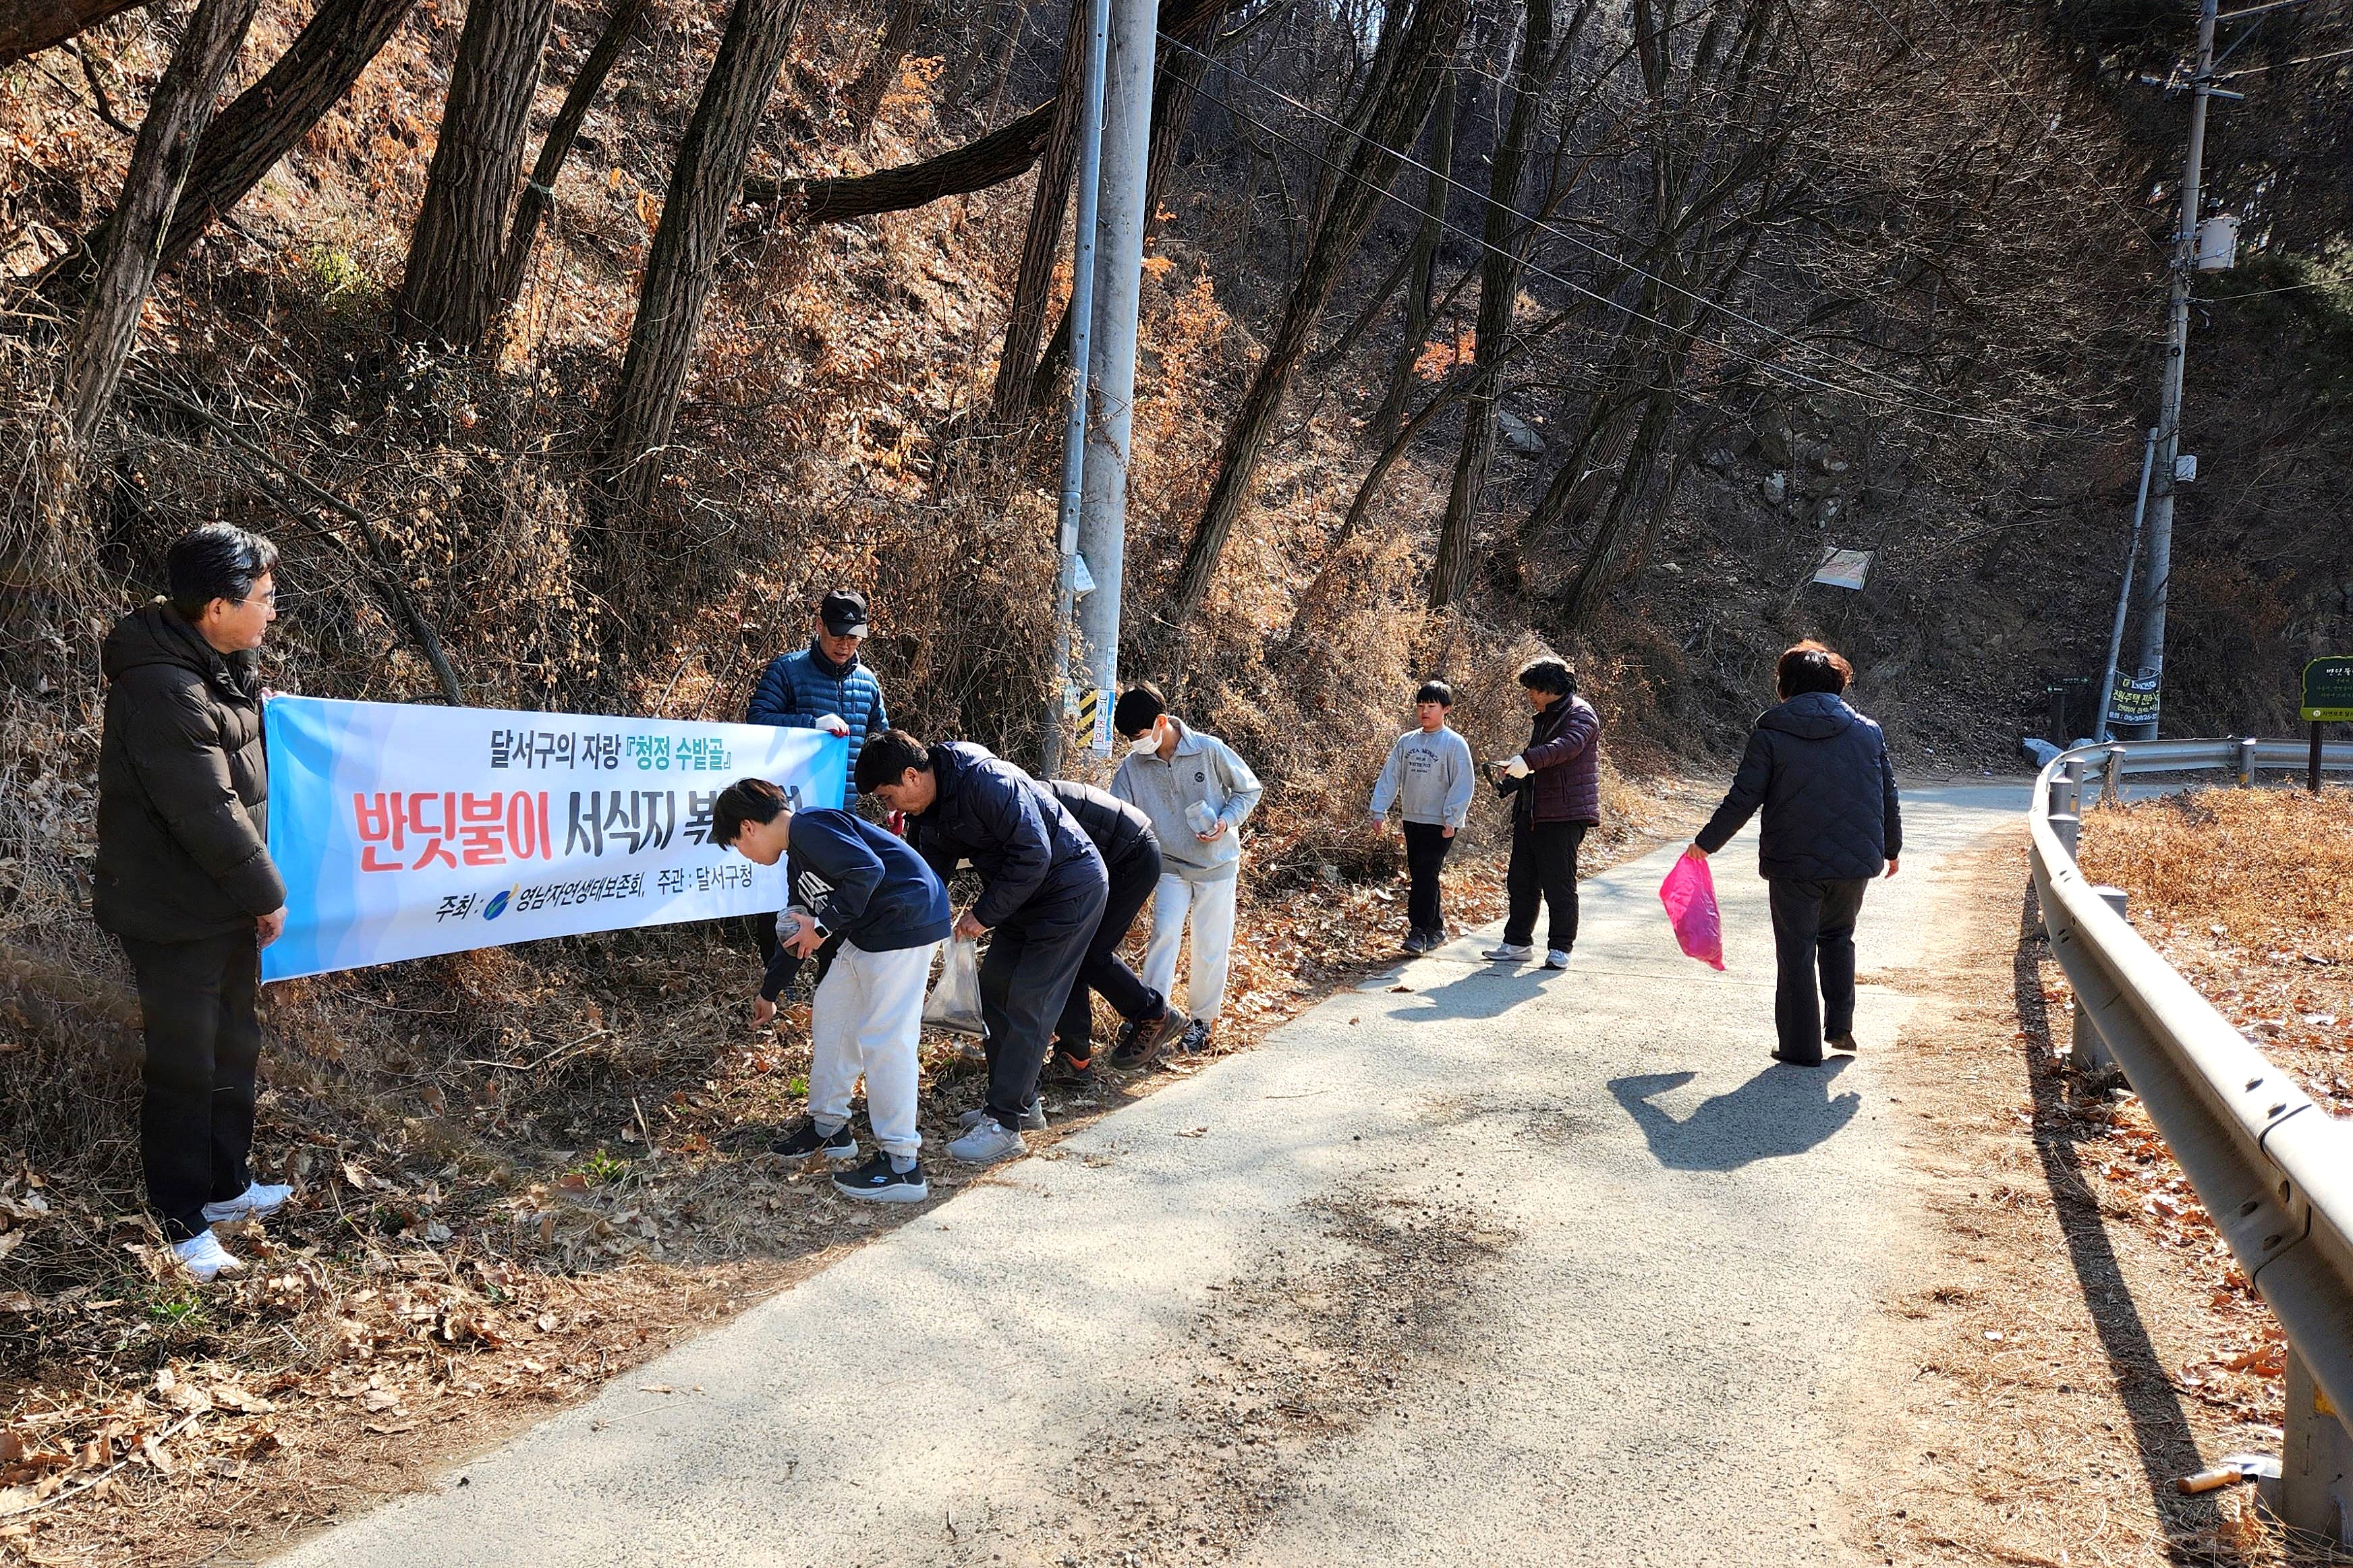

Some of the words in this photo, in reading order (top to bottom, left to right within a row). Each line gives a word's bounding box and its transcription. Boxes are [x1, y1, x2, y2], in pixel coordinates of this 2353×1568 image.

[2326, 668, 2353, 676] 반딧불
[490, 729, 576, 770] 달서구의
[582, 732, 621, 770] 자랑
[353, 791, 551, 871] 반딧불이
[565, 790, 675, 857] 서식지
[435, 893, 476, 923] 주최
[657, 868, 684, 895] 주관
[696, 863, 752, 892] 달서구청
